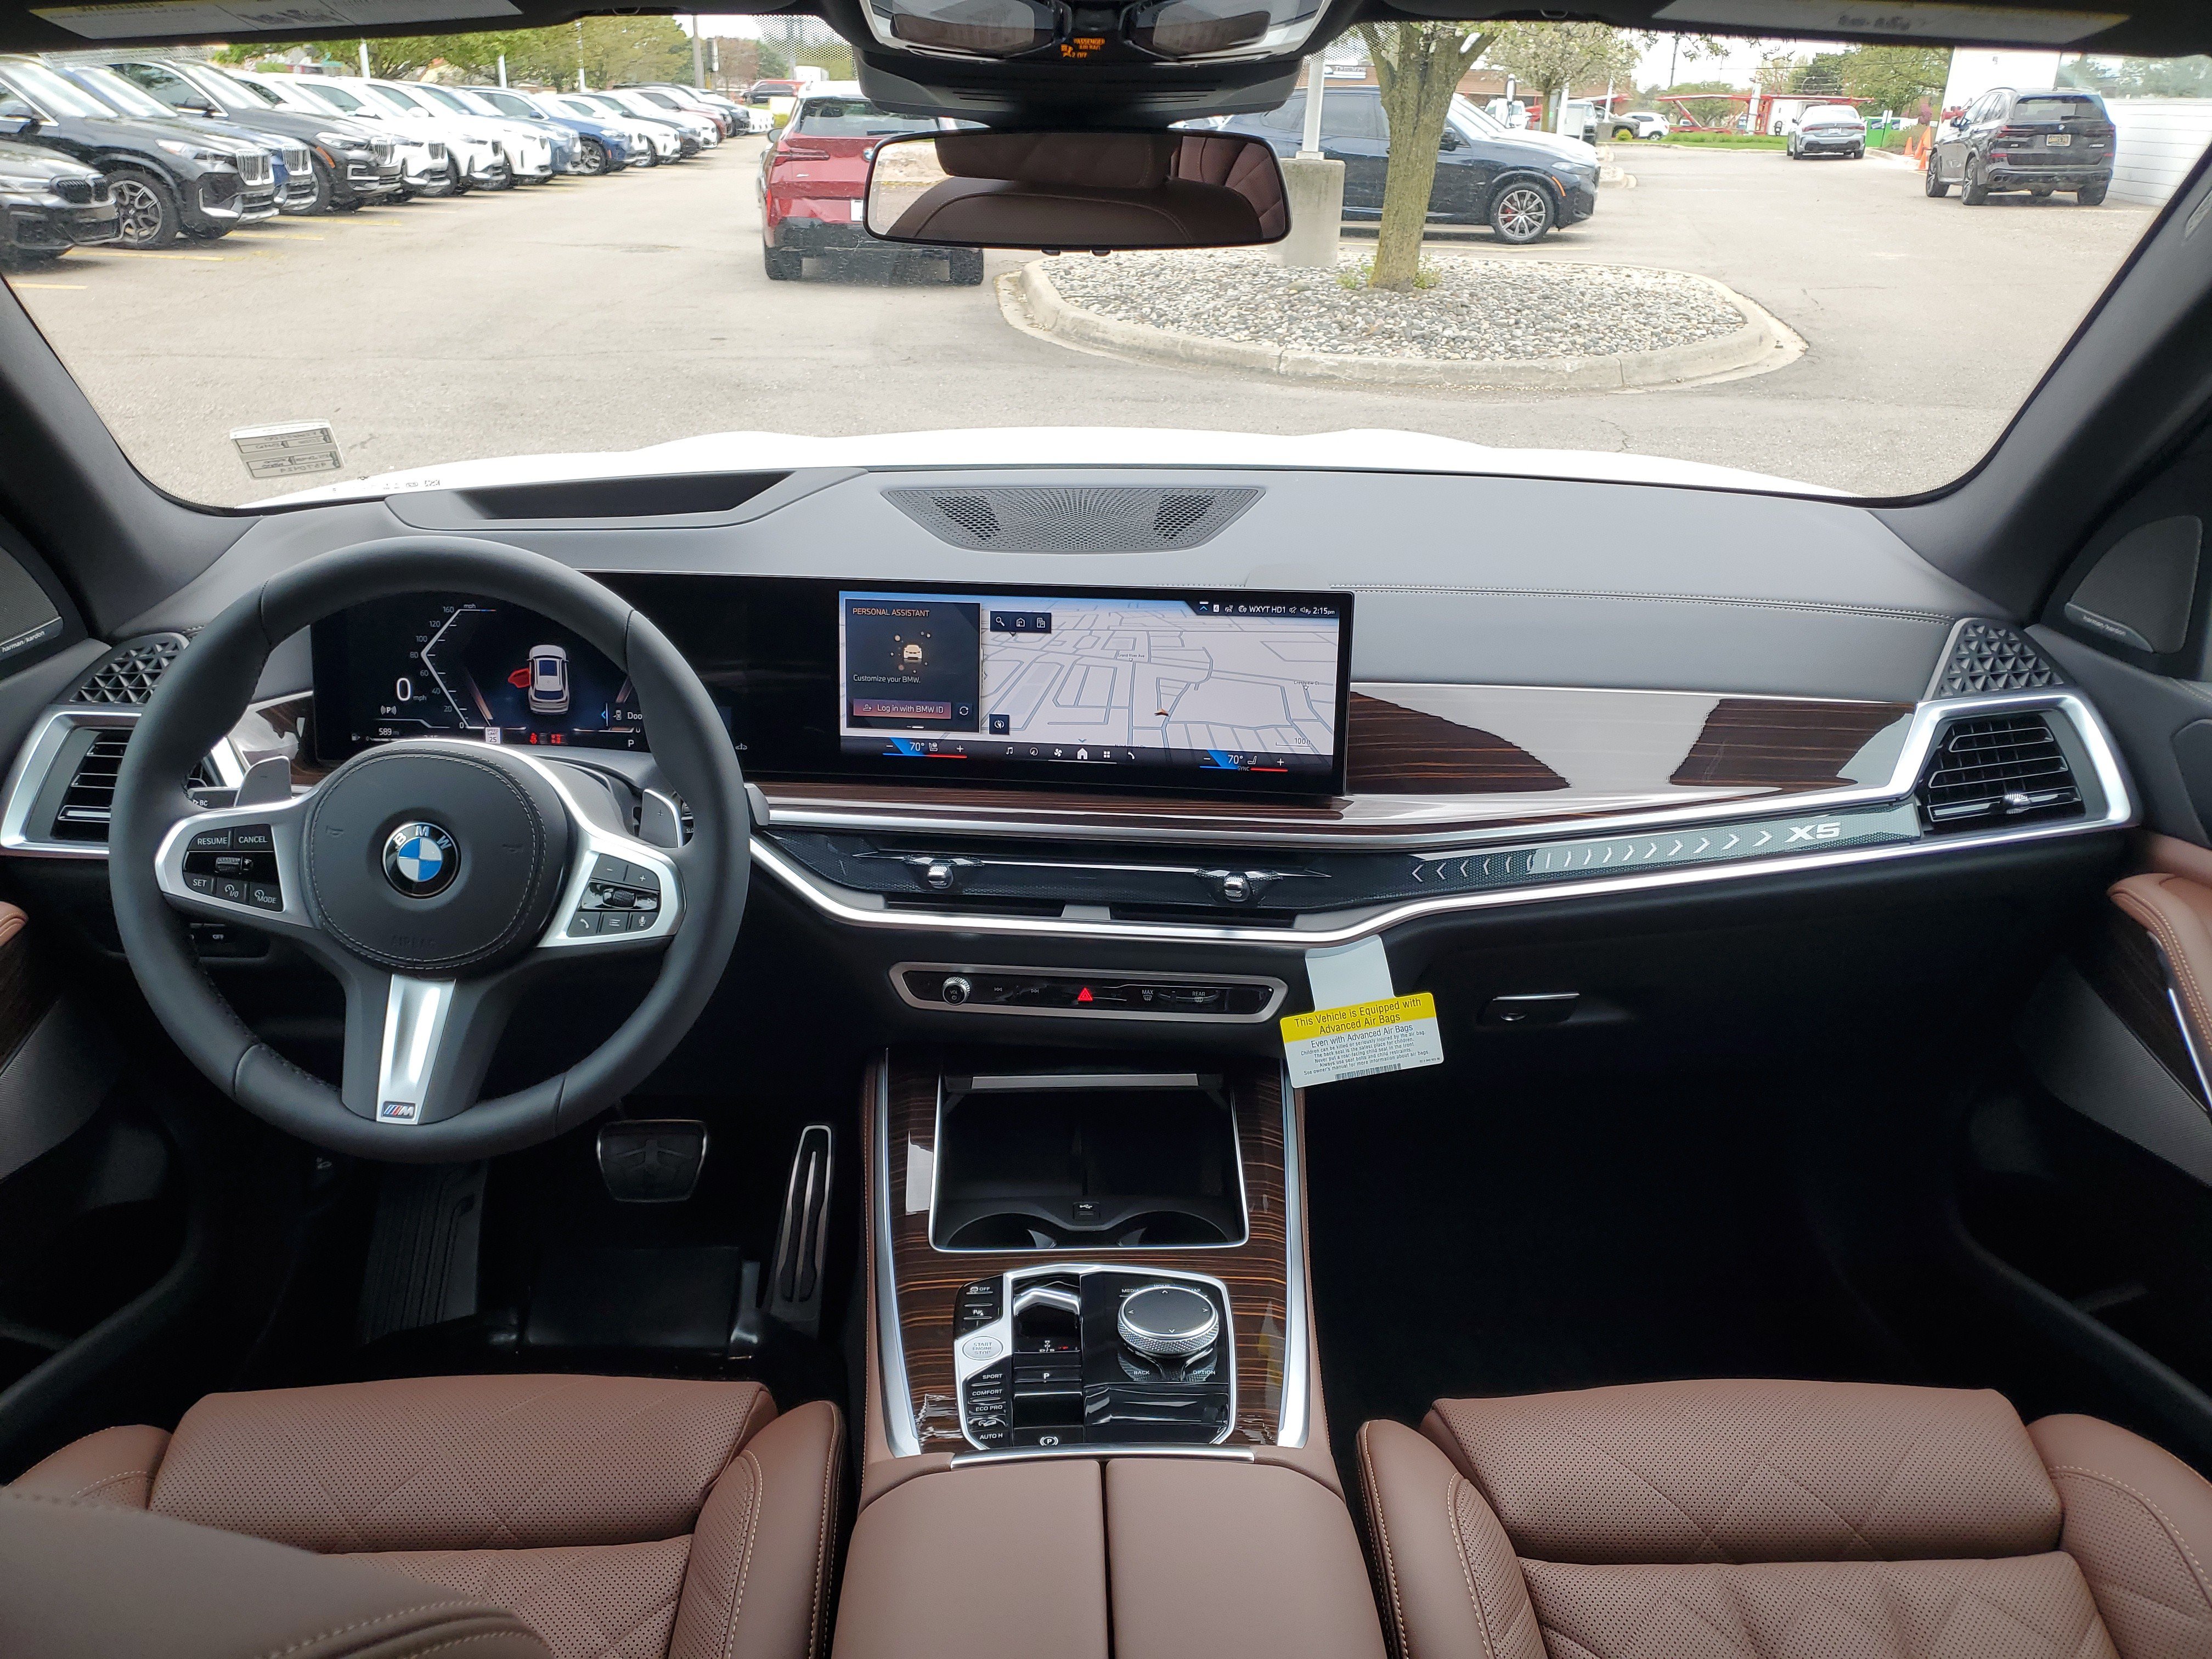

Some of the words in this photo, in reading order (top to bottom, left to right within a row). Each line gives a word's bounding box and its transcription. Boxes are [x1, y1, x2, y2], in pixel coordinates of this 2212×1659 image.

[853, 608, 890, 616] PERSONAL
[1312, 607, 1335, 615] 2:15pm
[2, 631, 46, 653] harman/kardon
[396, 678, 411, 701] 0
[877, 704, 890, 713] Log
[627, 712, 642, 720] Doo
[628, 739, 634, 747] P
[909, 741, 926, 752] 70°
[1227, 754, 1243, 764] 70°
[1784, 822, 1841, 843] X5
[197, 837, 228, 845] RESUME
[238, 836, 268, 844] CANCEL
[393, 825, 452, 850] BMW
[192, 879, 207, 887] SET
[257, 895, 276, 904] MODE
[1294, 1018, 1313, 1028] This
[1315, 1011, 1347, 1024] Vehicle
[1349, 1009, 1357, 1018] is
[1359, 1001, 1400, 1016] Equipped
[1402, 997, 1421, 1008] with
[1319, 1019, 1361, 1035] Advanced
[1364, 1016, 1376, 1026] Air
[1379, 1013, 1401, 1024] Bags
[1311, 1039, 1328, 1048] Even
[1330, 1035, 1345, 1045] with
[1347, 1028, 1381, 1042] Advanced
[1383, 1026, 1393, 1036] Air
[1395, 1024, 1413, 1033] Bags
[1341, 1051, 1365, 1059] rear-facing
